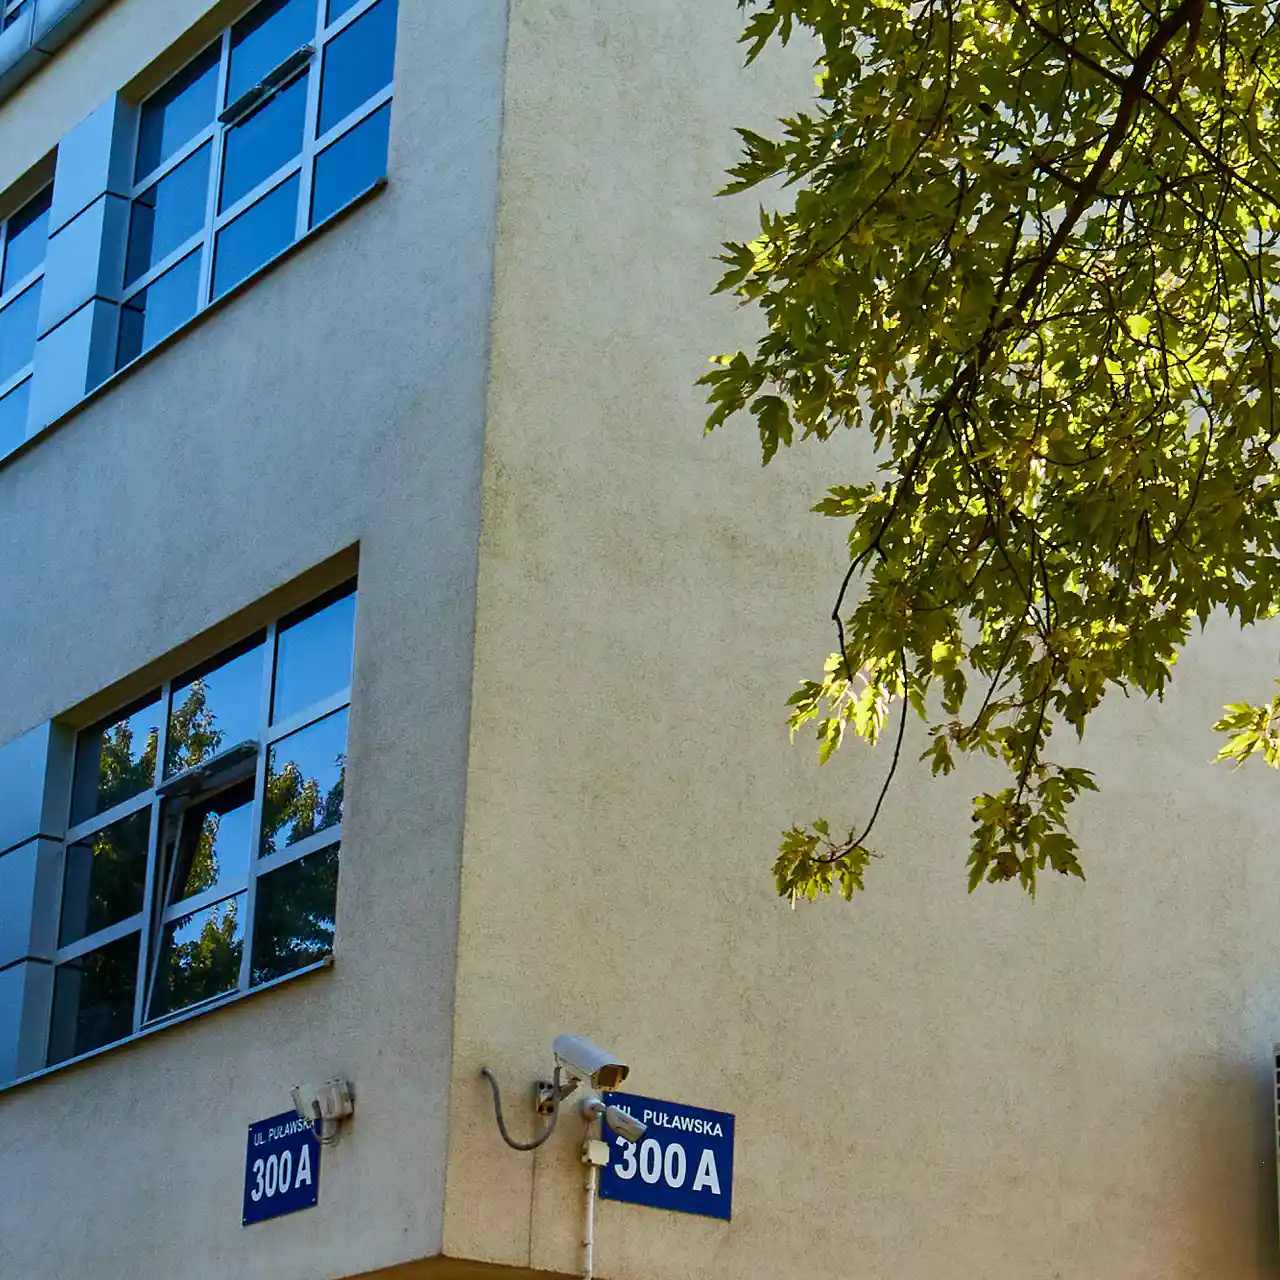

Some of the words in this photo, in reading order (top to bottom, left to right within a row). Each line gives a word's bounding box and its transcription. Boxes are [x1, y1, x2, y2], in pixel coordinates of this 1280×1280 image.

[643, 1109, 723, 1137] PUŁAWSKA
[251, 1149, 292, 1201] 300
[294, 1144, 312, 1188] A
[614, 1135, 687, 1188] 300
[692, 1148, 721, 1195] A
